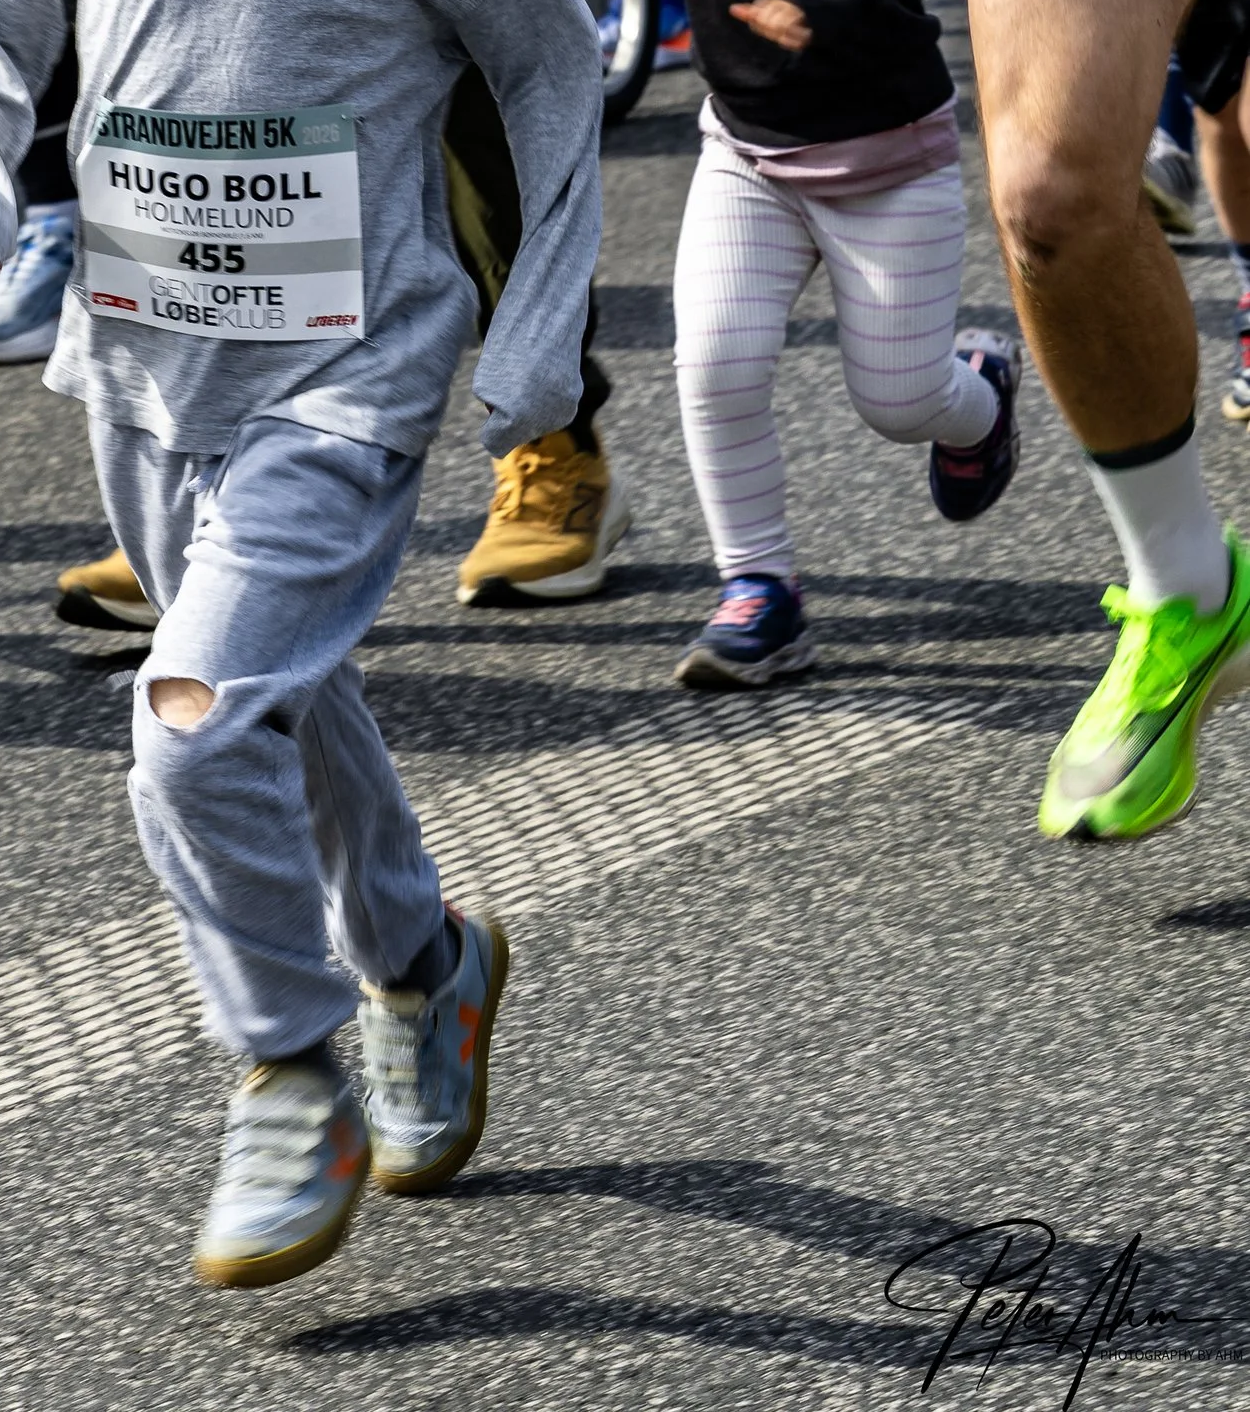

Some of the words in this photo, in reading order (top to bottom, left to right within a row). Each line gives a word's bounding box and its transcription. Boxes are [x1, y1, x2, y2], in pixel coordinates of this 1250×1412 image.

[98, 111, 256, 150] STRANDVEJEN
[263, 116, 298, 149] 5K
[302, 123, 340, 145] 2026
[108, 160, 210, 202] HUGO
[223, 171, 323, 203] BOLL
[133, 197, 295, 228] HOLMELUND
[178, 242, 246, 274] 455
[149, 274, 284, 307] GENTOFTE
[151, 298, 288, 330] LØBEKLUB
